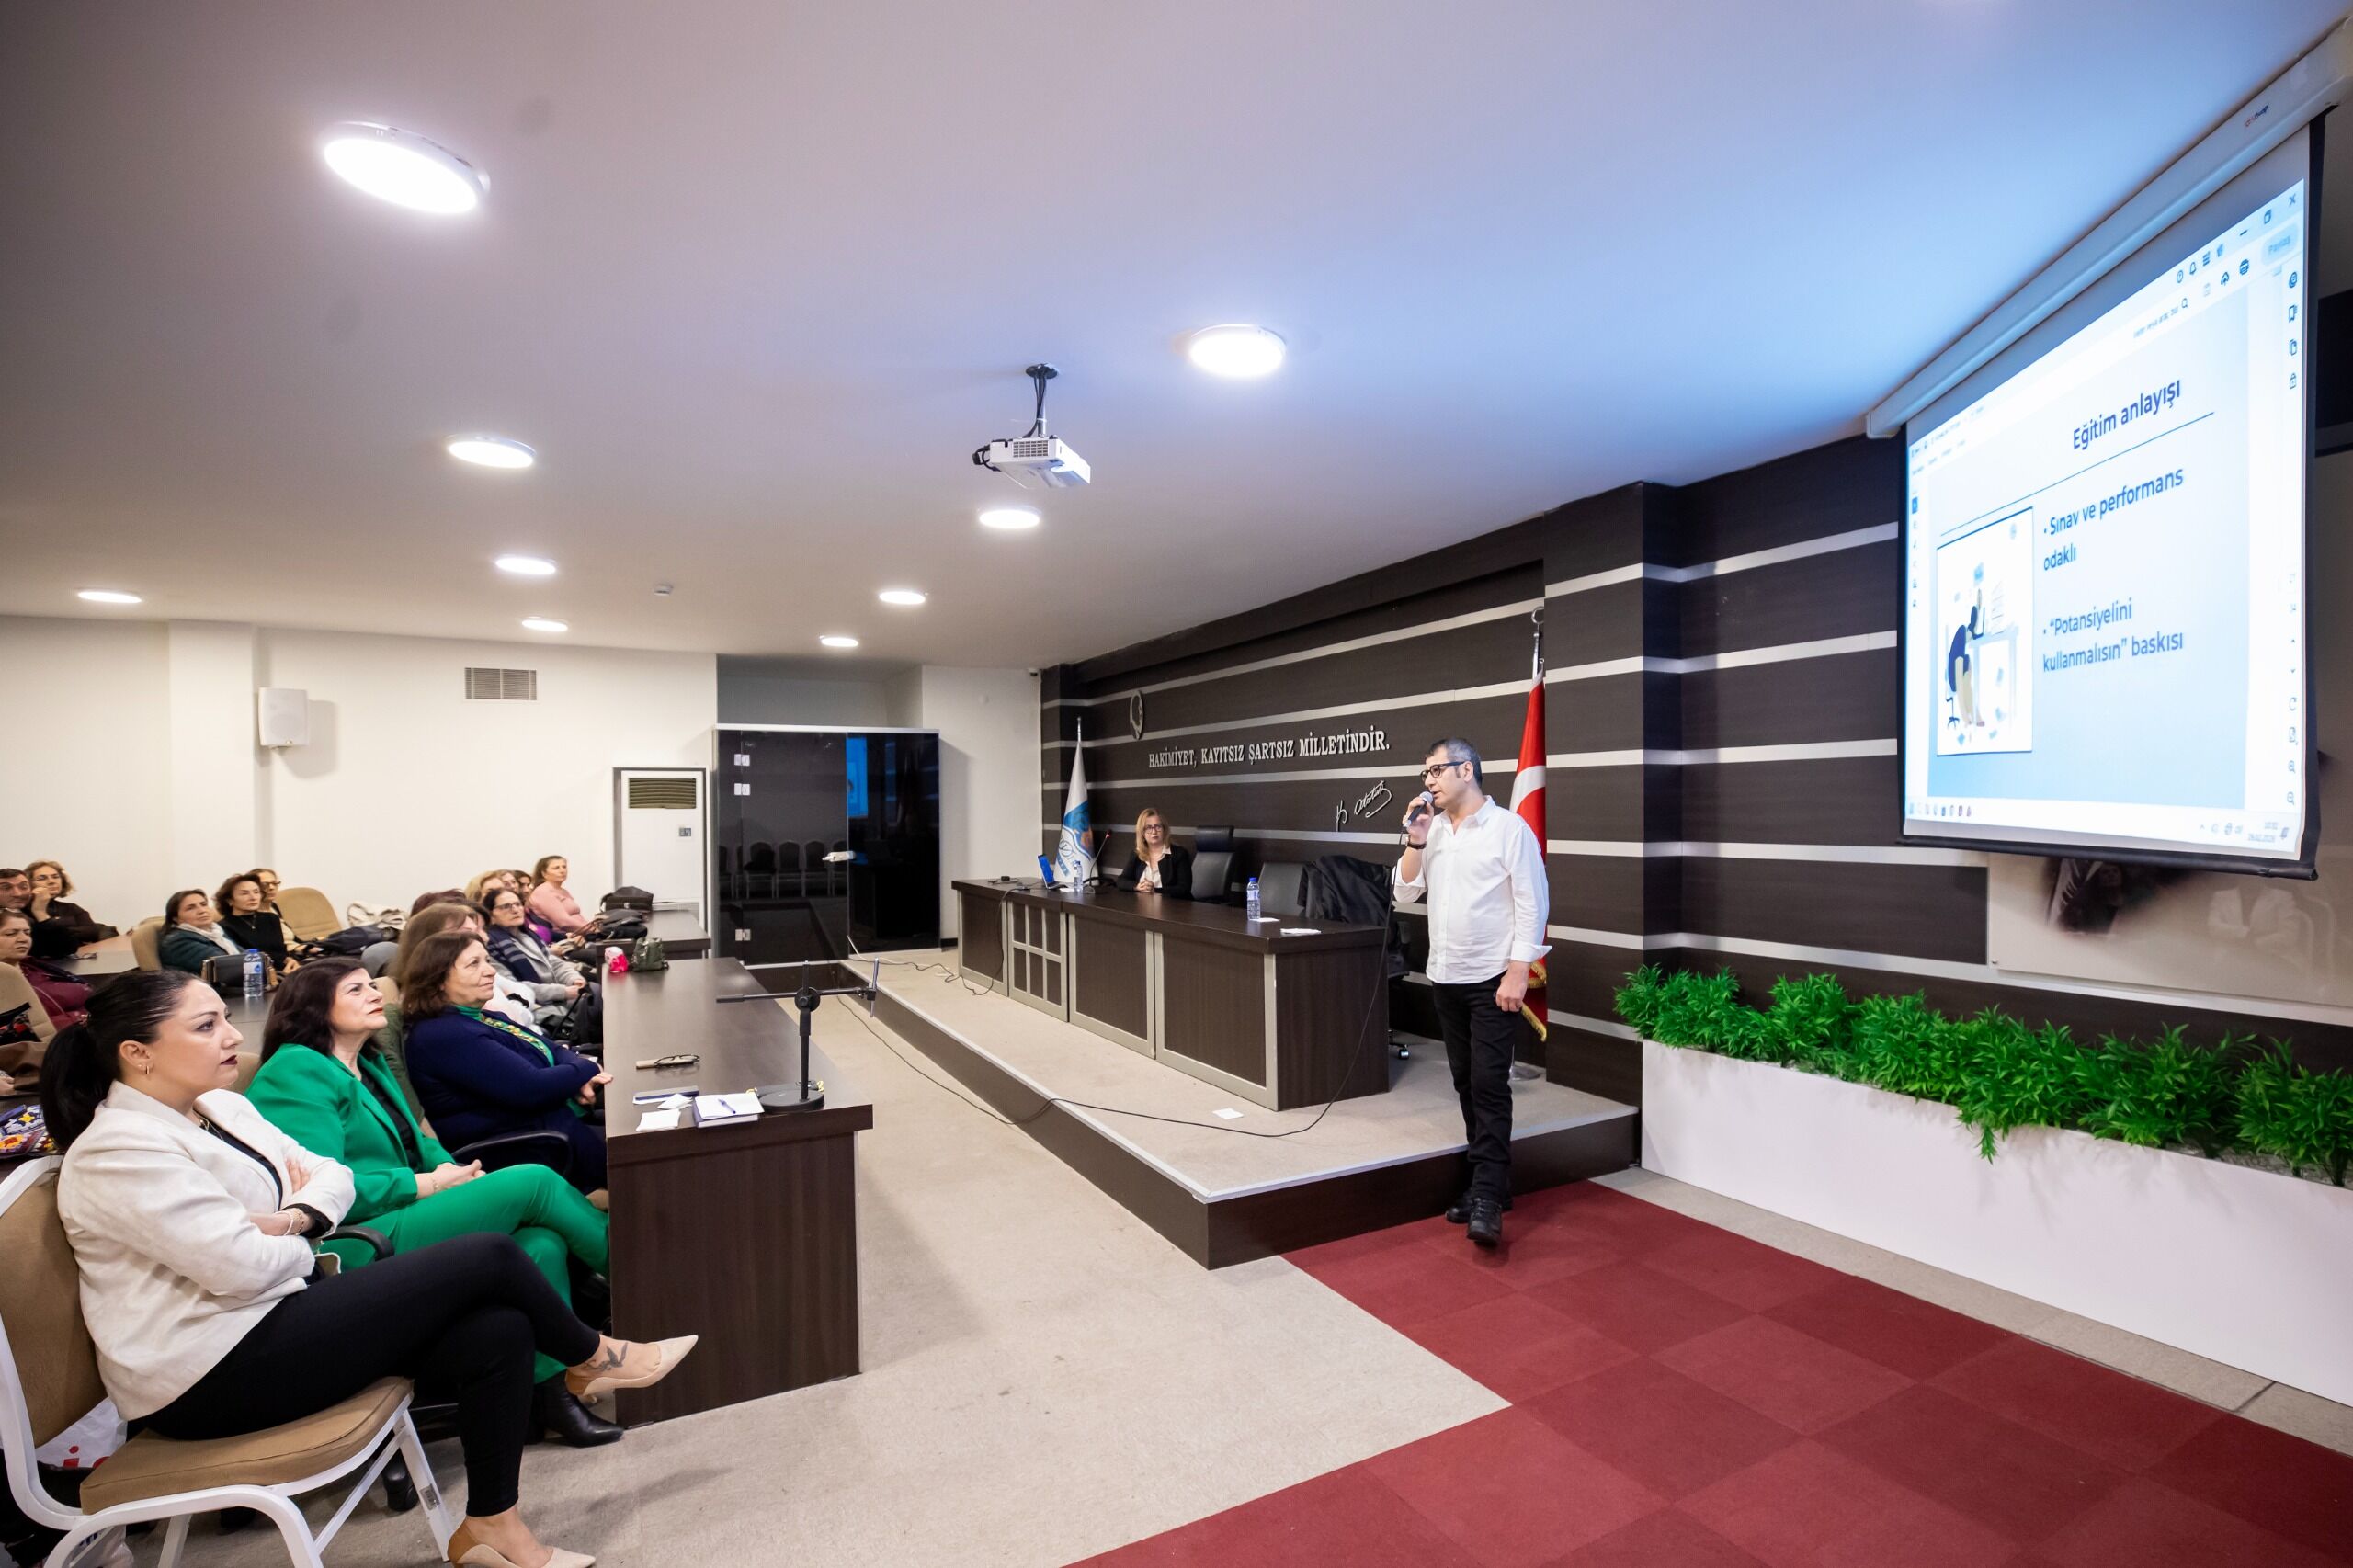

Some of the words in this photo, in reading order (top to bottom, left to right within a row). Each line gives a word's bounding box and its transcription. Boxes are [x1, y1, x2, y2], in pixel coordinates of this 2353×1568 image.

[2073, 414, 2117, 450] Eğitim
[2120, 380, 2180, 426] anlayışı
[2050, 510, 2079, 536] Sınav
[2082, 504, 2097, 522] ve
[2099, 469, 2184, 521] performans
[2043, 542, 2076, 571] odaklı
[2131, 631, 2184, 657] baskısı
[1149, 745, 1197, 768] HAKİMİYET,
[1200, 744, 1245, 764] KAYITSIZ
[1248, 739, 1294, 765] ŞARTSIZ
[1299, 724, 1390, 757] MİLLETİNDİR.
